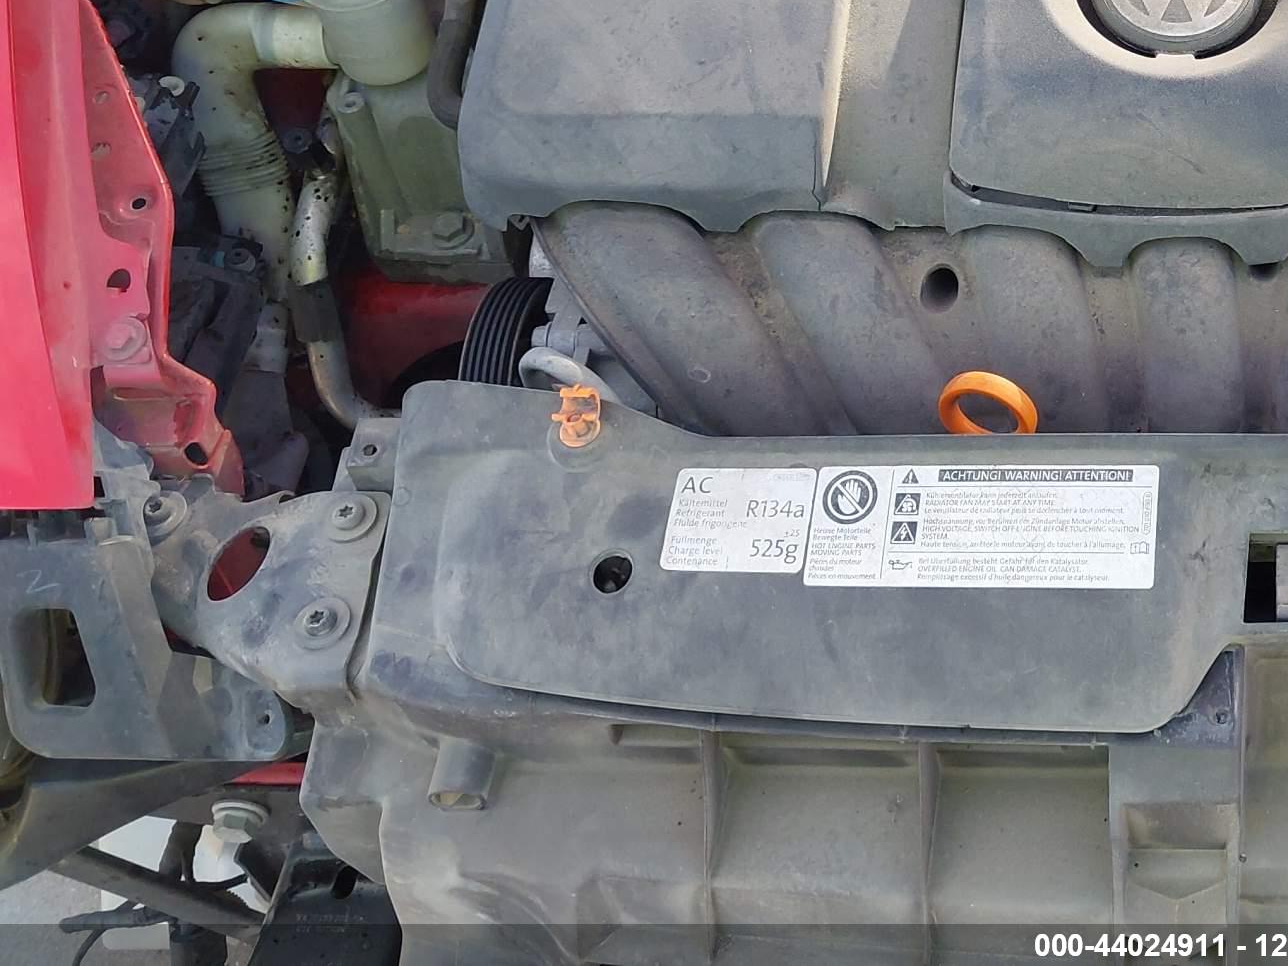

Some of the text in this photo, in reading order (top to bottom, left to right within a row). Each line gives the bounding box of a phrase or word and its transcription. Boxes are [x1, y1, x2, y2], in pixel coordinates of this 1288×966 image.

[943, 471, 1129, 481] ACHTUNG! WARNING! ATTENTION!
[681, 476, 713, 494] AC
[675, 509, 725, 519] Refrigerant
[746, 499, 805, 518] R134a
[668, 545, 723, 556] Charge level
[749, 538, 799, 565] 525g
[666, 556, 718, 566] Contenance
